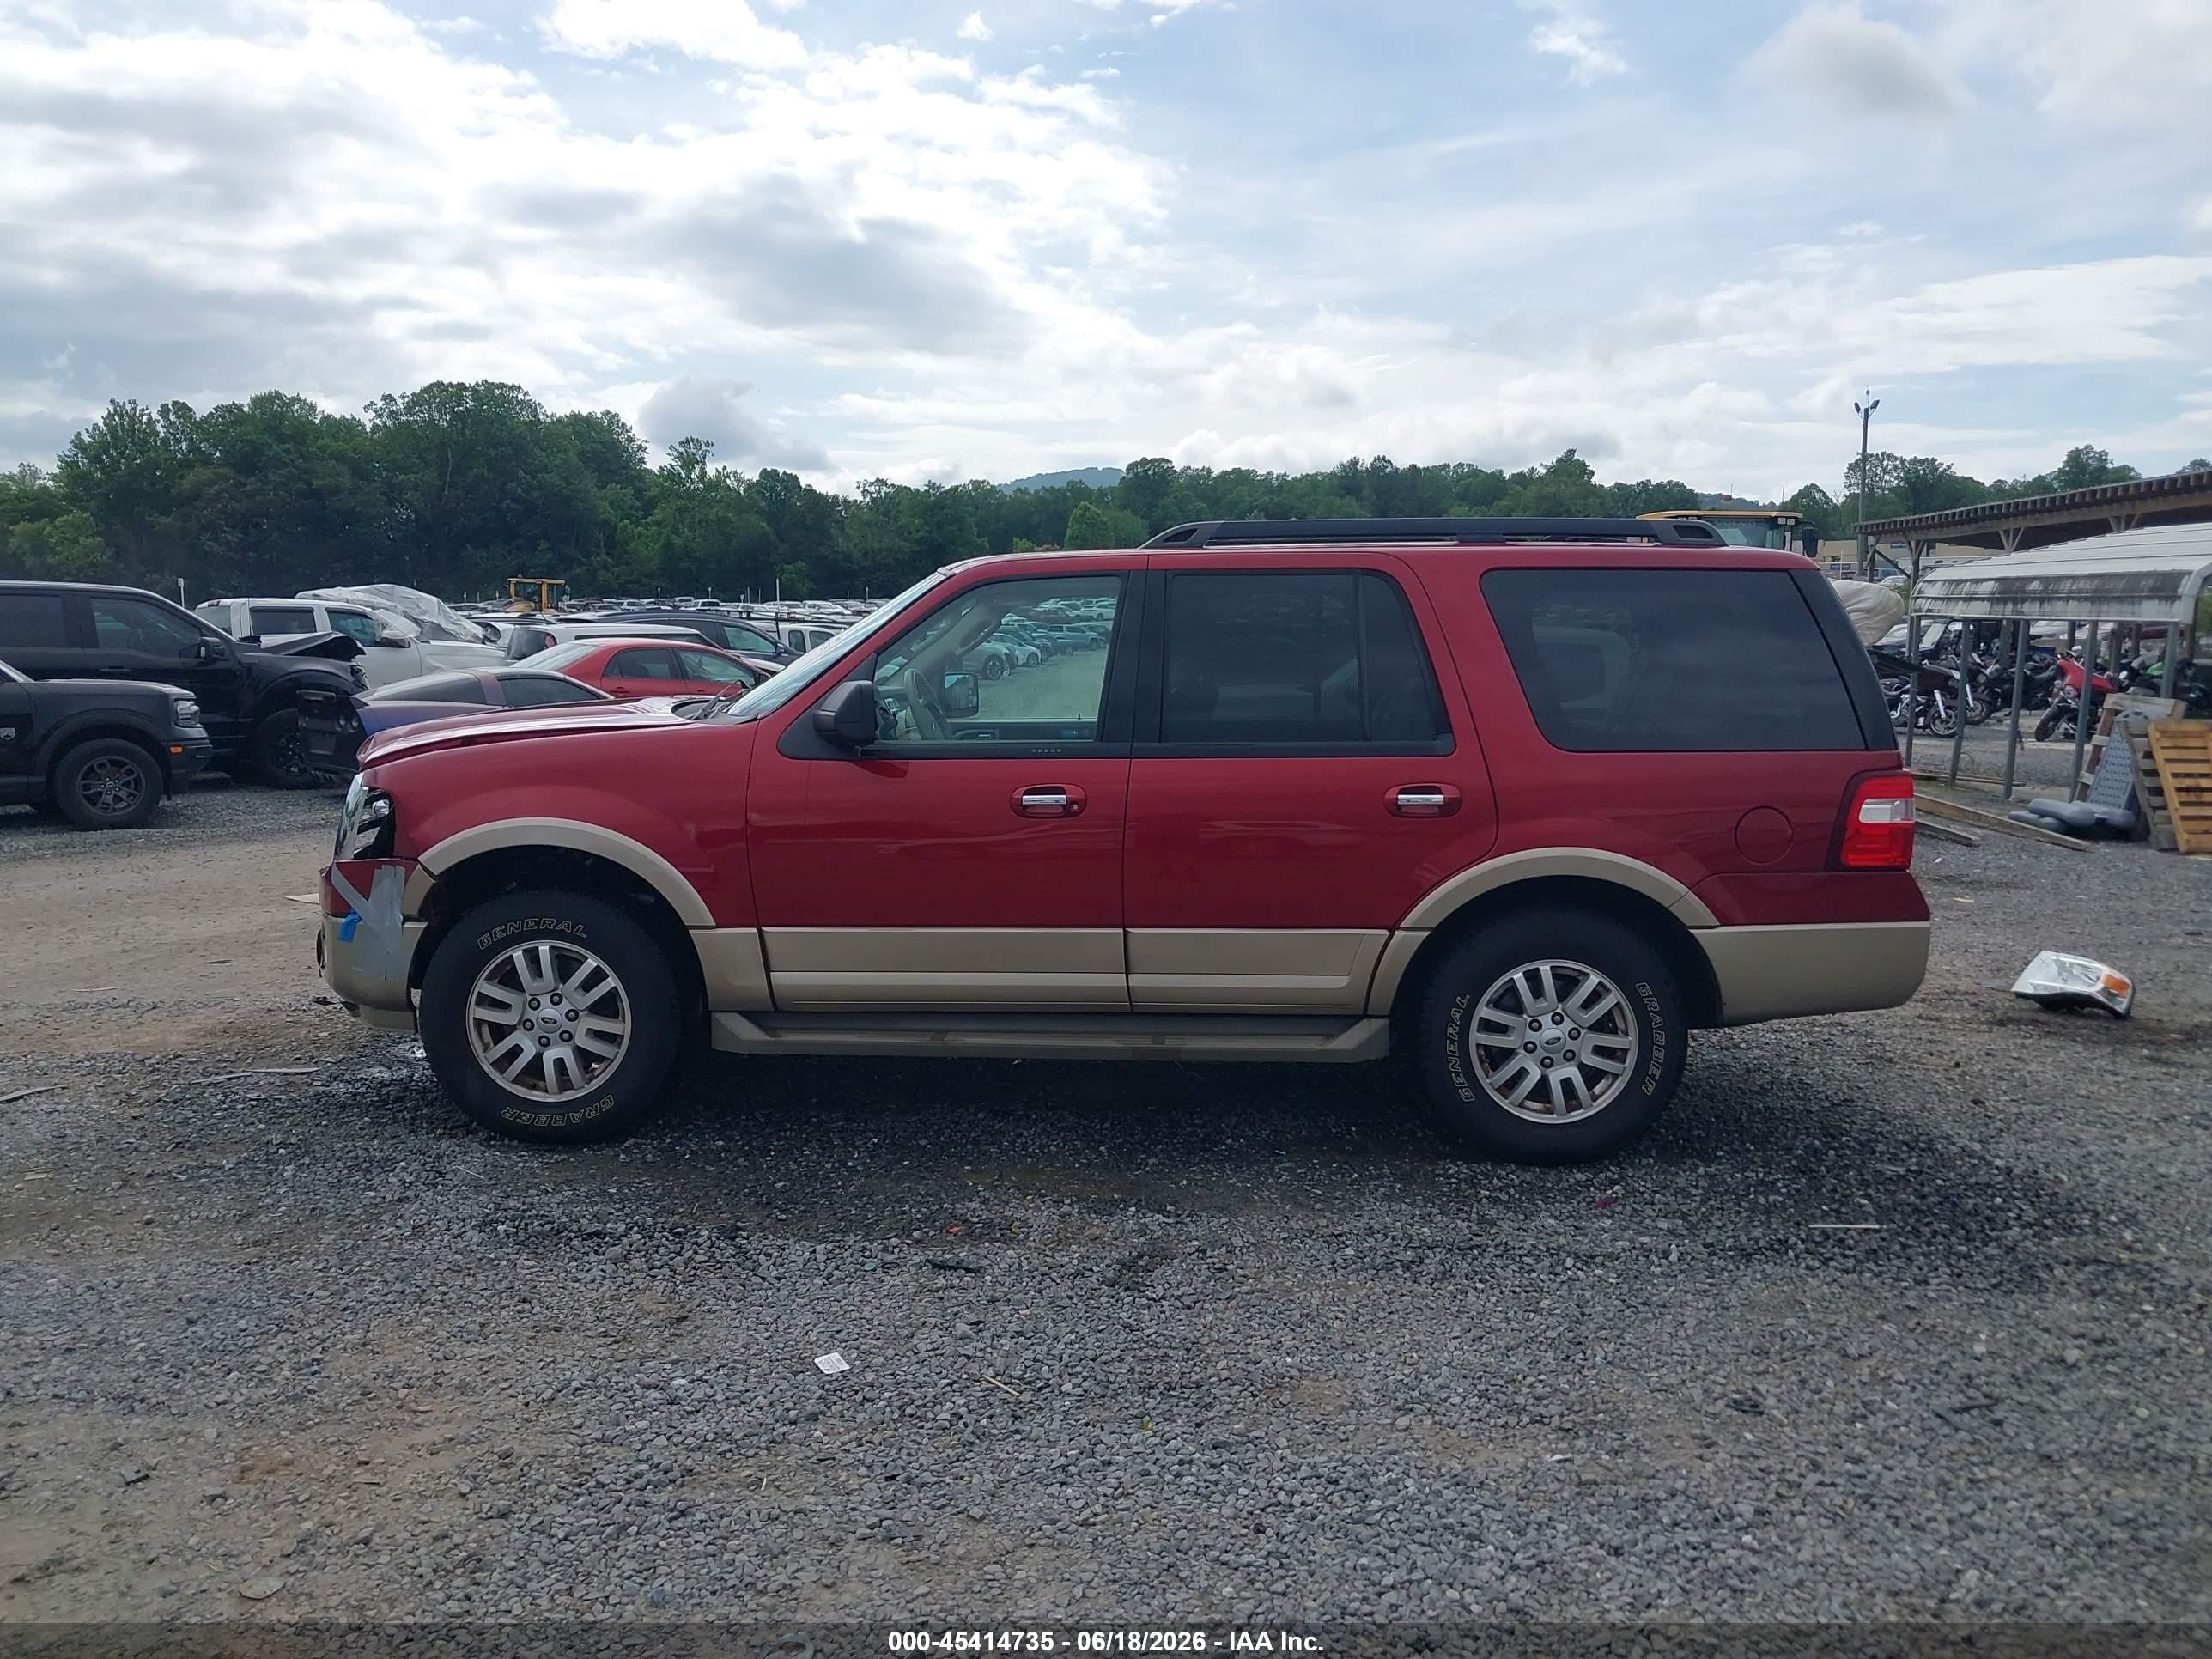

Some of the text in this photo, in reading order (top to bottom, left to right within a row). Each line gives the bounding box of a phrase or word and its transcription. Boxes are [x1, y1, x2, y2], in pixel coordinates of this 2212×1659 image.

[478, 917, 588, 951] GENERAL
[1443, 993, 1476, 1103] GENERAL
[1634, 981, 1666, 1097] GRABBER
[500, 1094, 615, 1127] GRABBER
